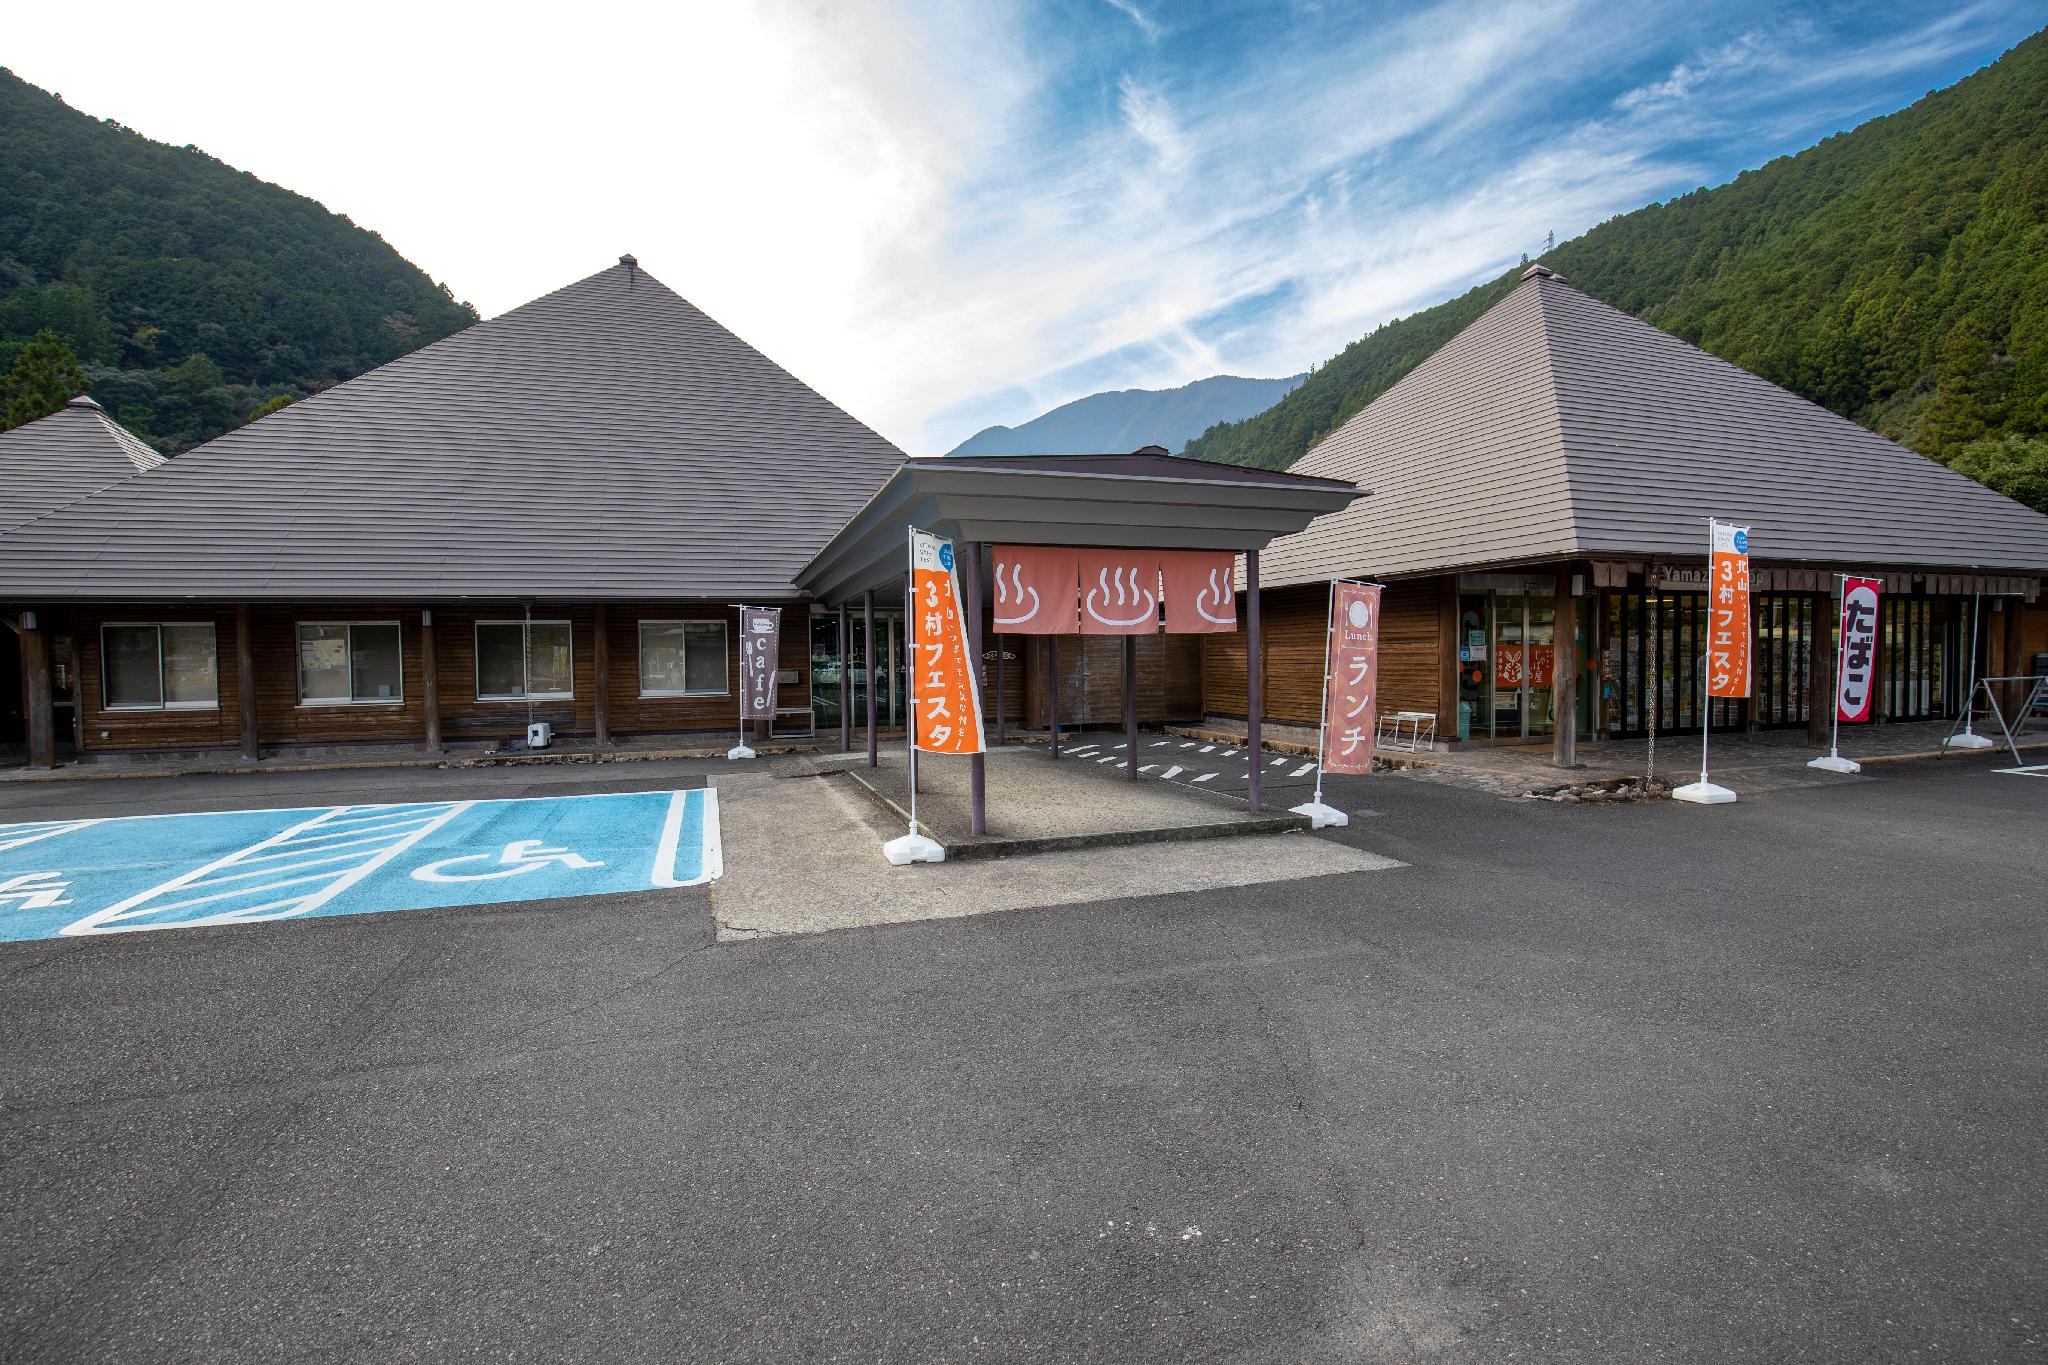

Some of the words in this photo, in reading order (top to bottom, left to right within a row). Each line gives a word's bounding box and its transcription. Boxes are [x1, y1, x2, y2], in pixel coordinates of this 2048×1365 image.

[1664, 565, 1709, 582] Yamaz
[753, 637, 767, 710] cafe
[924, 580, 951, 747] 3村フェスタ
[1344, 629, 1373, 641] Lunch
[1711, 560, 1735, 690] 3村フェスタ
[1843, 599, 1875, 706] たばこ
[1340, 656, 1369, 756] ランチ
